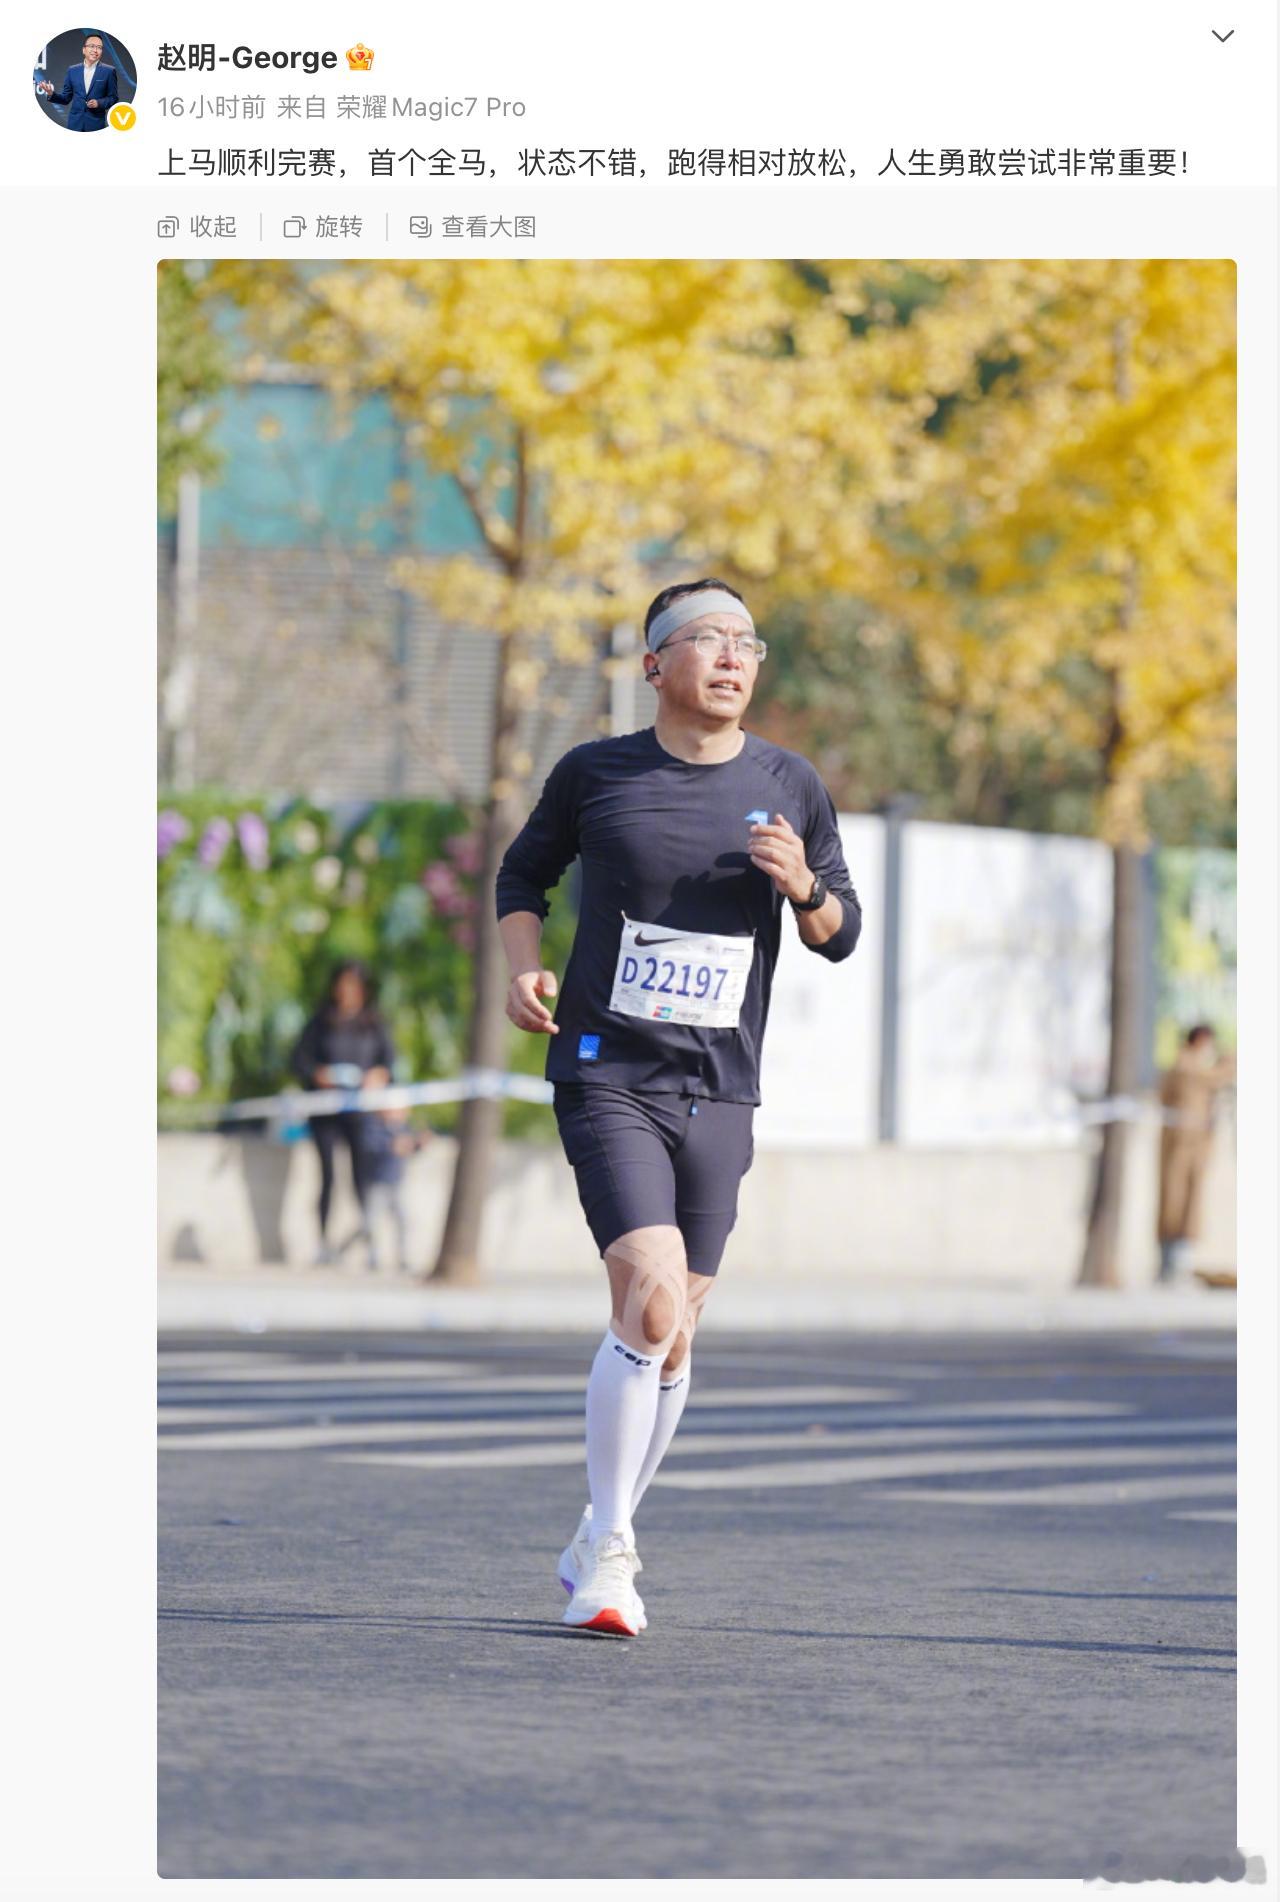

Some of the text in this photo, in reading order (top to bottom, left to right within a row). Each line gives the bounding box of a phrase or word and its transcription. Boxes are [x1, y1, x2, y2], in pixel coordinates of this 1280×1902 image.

[157, 43, 338, 74] 赵明-George
[157, 94, 526, 122] 16小时前 来自 荣耀Magic7 Pro
[190, 214, 237, 239] 收起
[315, 214, 363, 239] 旋转
[441, 214, 536, 239] 查看大图
[621, 957, 728, 1000] D22197
